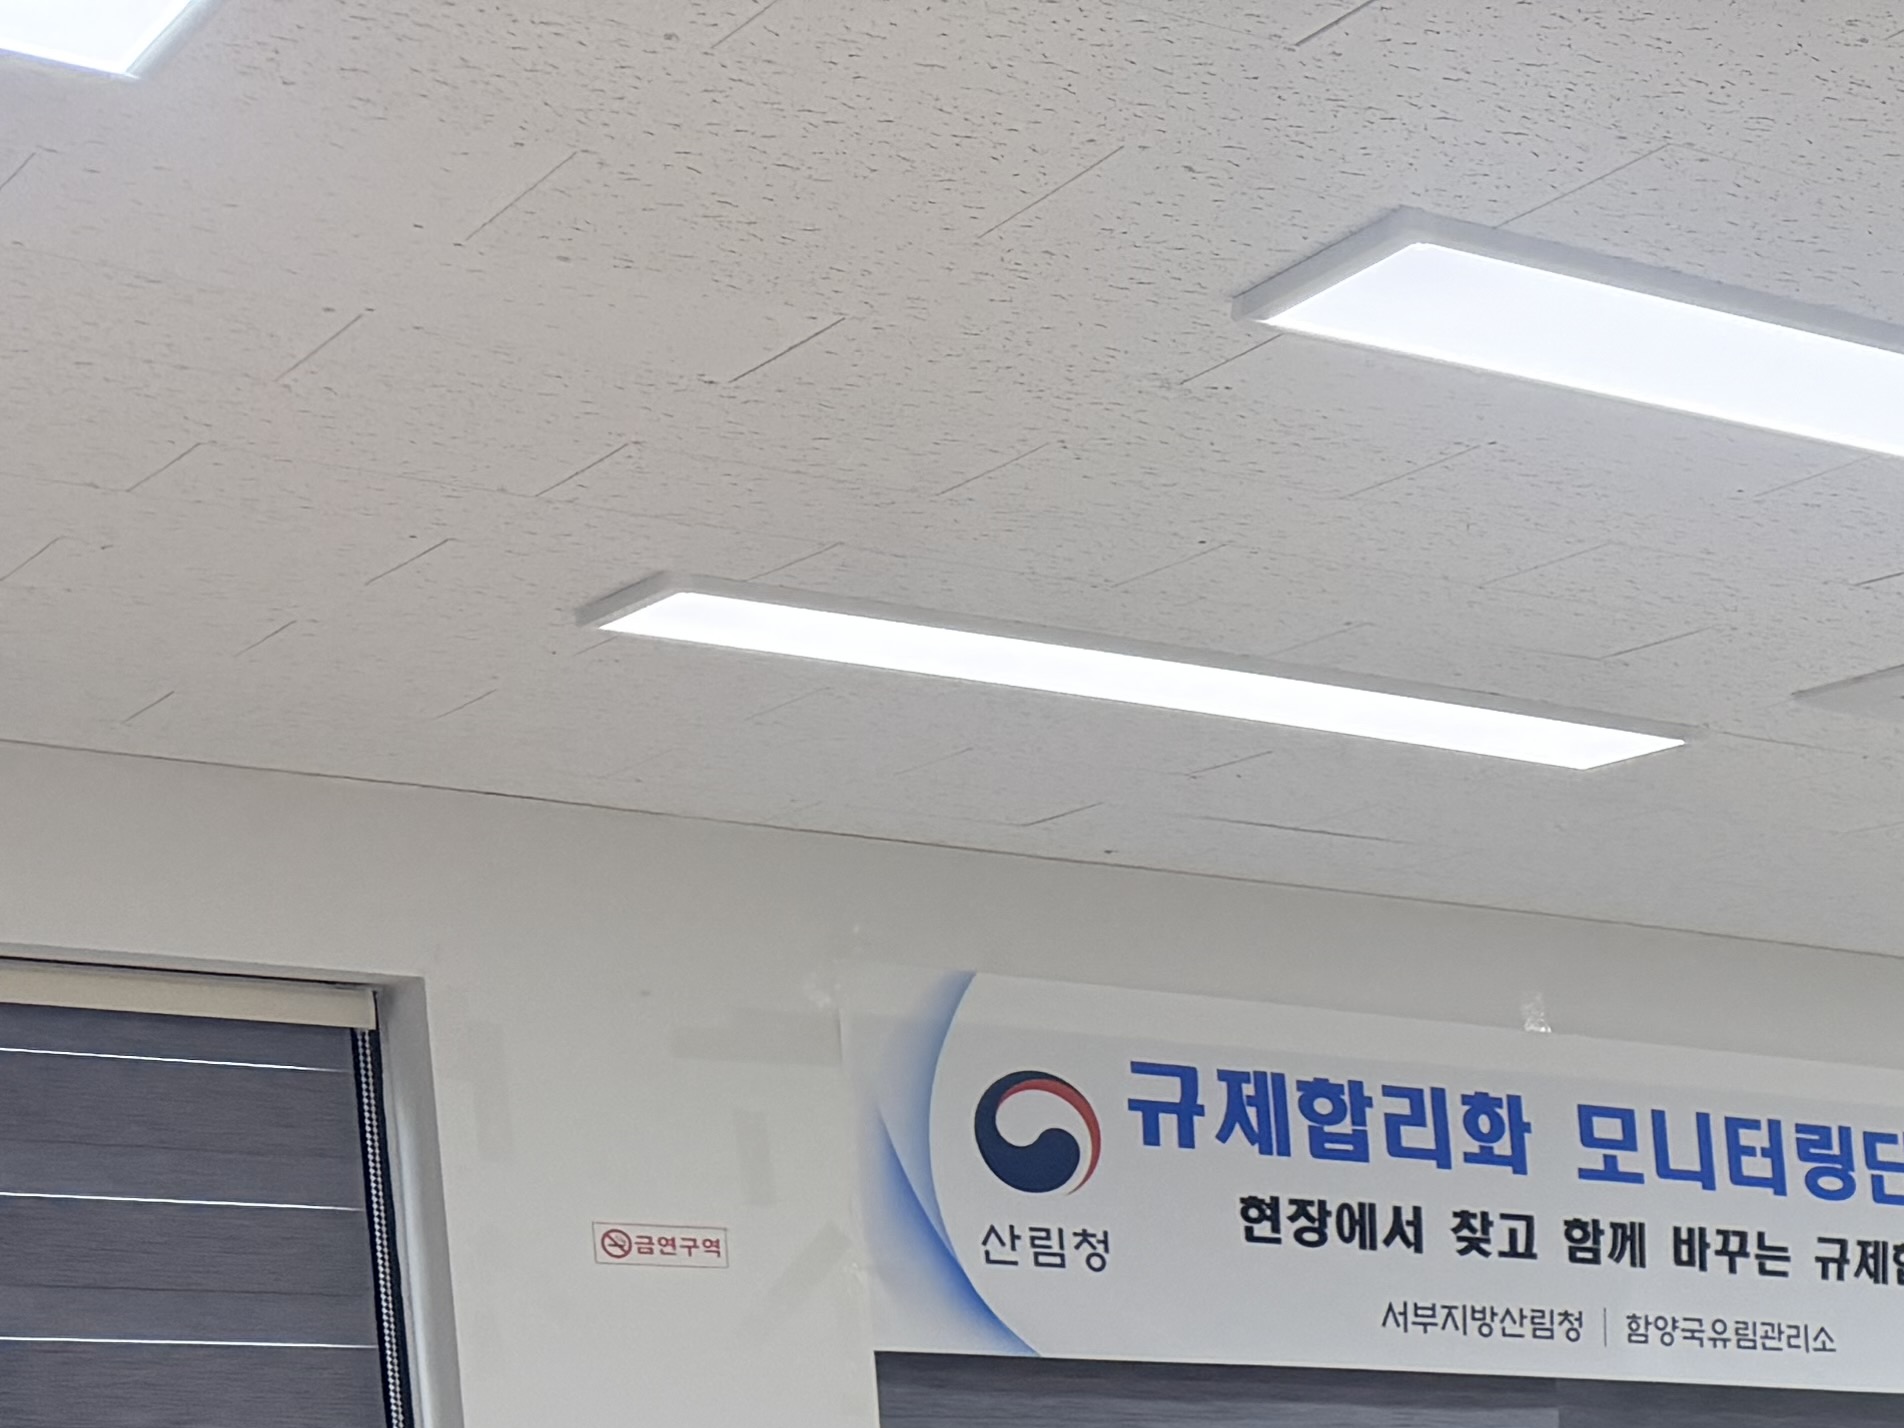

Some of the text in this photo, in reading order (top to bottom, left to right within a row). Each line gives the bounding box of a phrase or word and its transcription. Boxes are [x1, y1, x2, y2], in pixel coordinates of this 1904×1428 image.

[1127, 1060, 1532, 1176] 규제합리화
[634, 1235, 721, 1258] 금연구역
[980, 1223, 1111, 1272] 산림청
[1239, 1194, 1424, 1254] 현장에서
[1451, 1208, 1538, 1260] 찾고
[1563, 1218, 1646, 1269] 함께
[1673, 1225, 1791, 1278] 바꾸는
[1382, 1301, 1837, 1354] 서부지방산림청 함양국유림관리소
